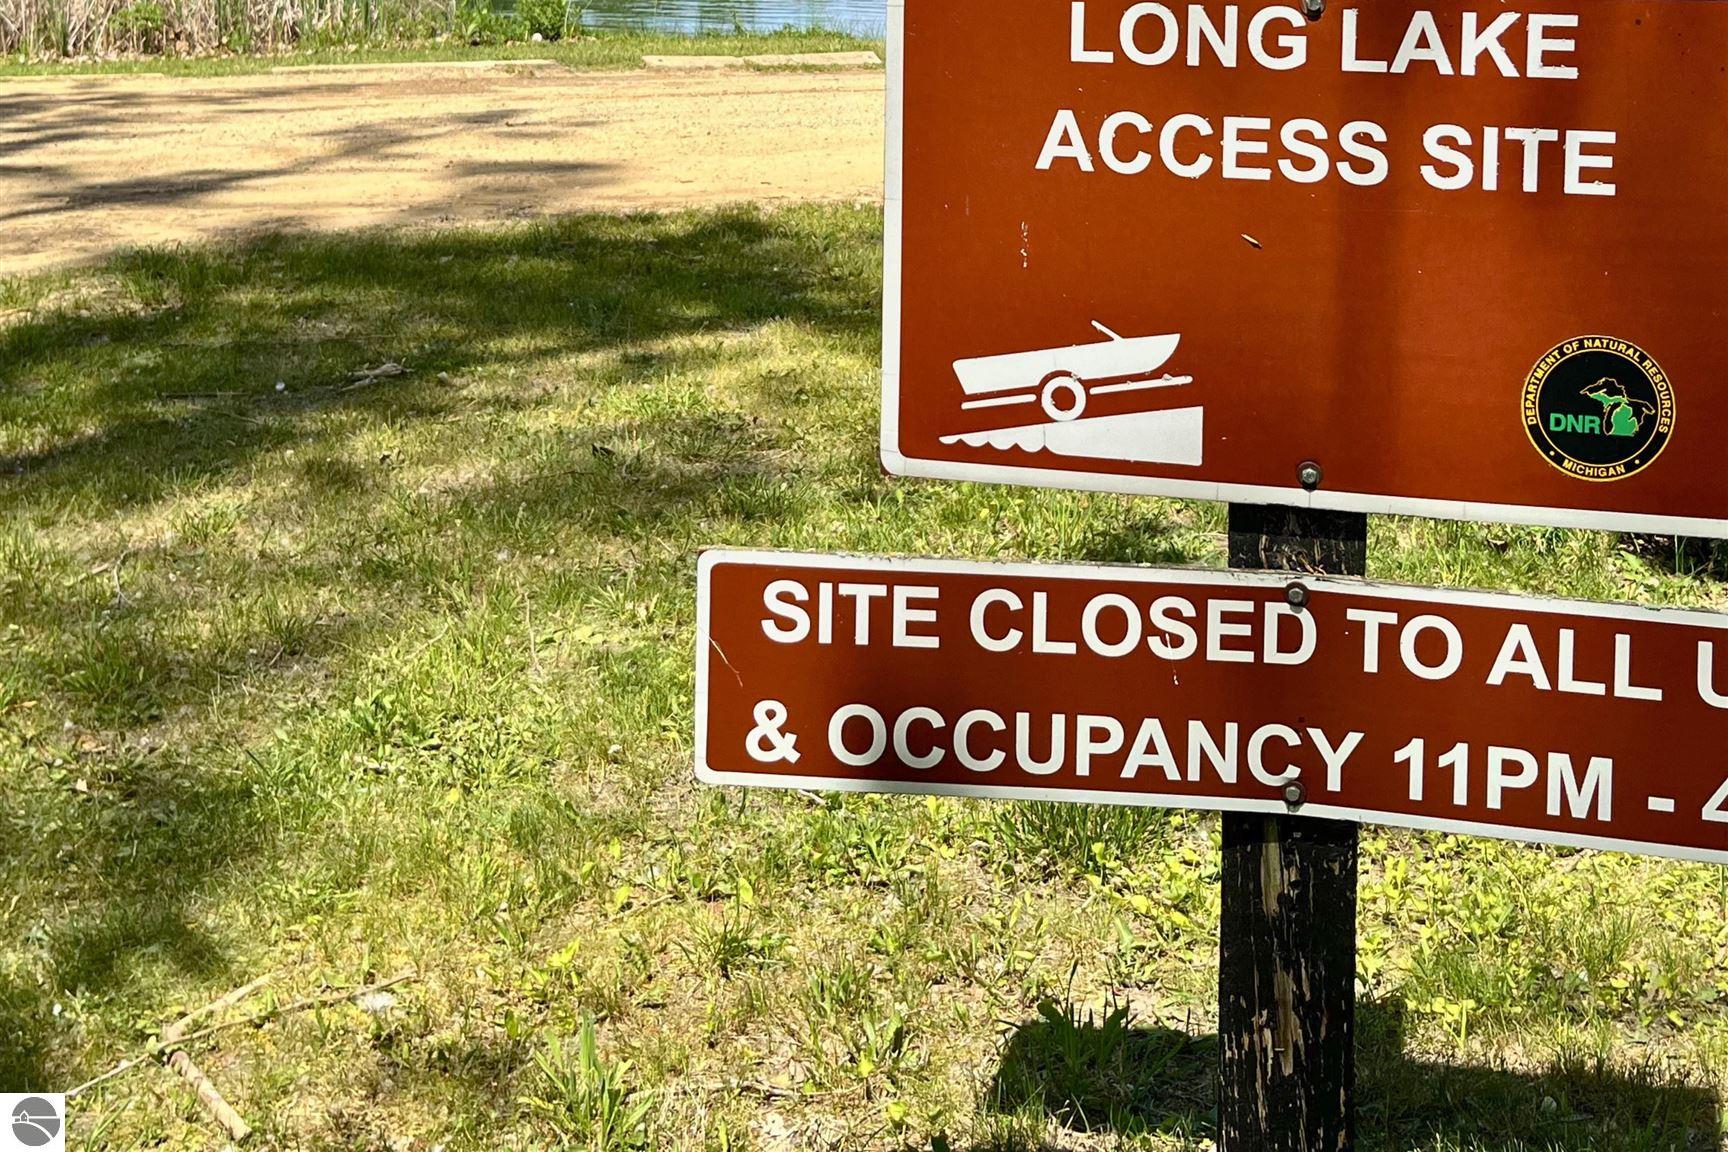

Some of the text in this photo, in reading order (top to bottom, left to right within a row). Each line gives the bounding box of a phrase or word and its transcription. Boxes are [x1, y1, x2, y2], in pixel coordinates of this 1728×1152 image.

[1070, 1, 1580, 80] LONG LAKE
[1034, 109, 1617, 196] ACCESS SITE
[1525, 339, 1672, 434] DEPARTMENT OF NATURAL RESOURCES
[1550, 413, 1600, 434] DNR
[1562, 458, 1626, 477] MICHIGAN
[760, 579, 940, 649] SITE
[969, 588, 1317, 665] CLOSED
[1346, 608, 1463, 680] TO
[1485, 623, 1663, 702] ALL
[745, 699, 802, 764] &
[827, 703, 1365, 792] OCCUPANCY
[1393, 737, 1613, 822] 11PM
